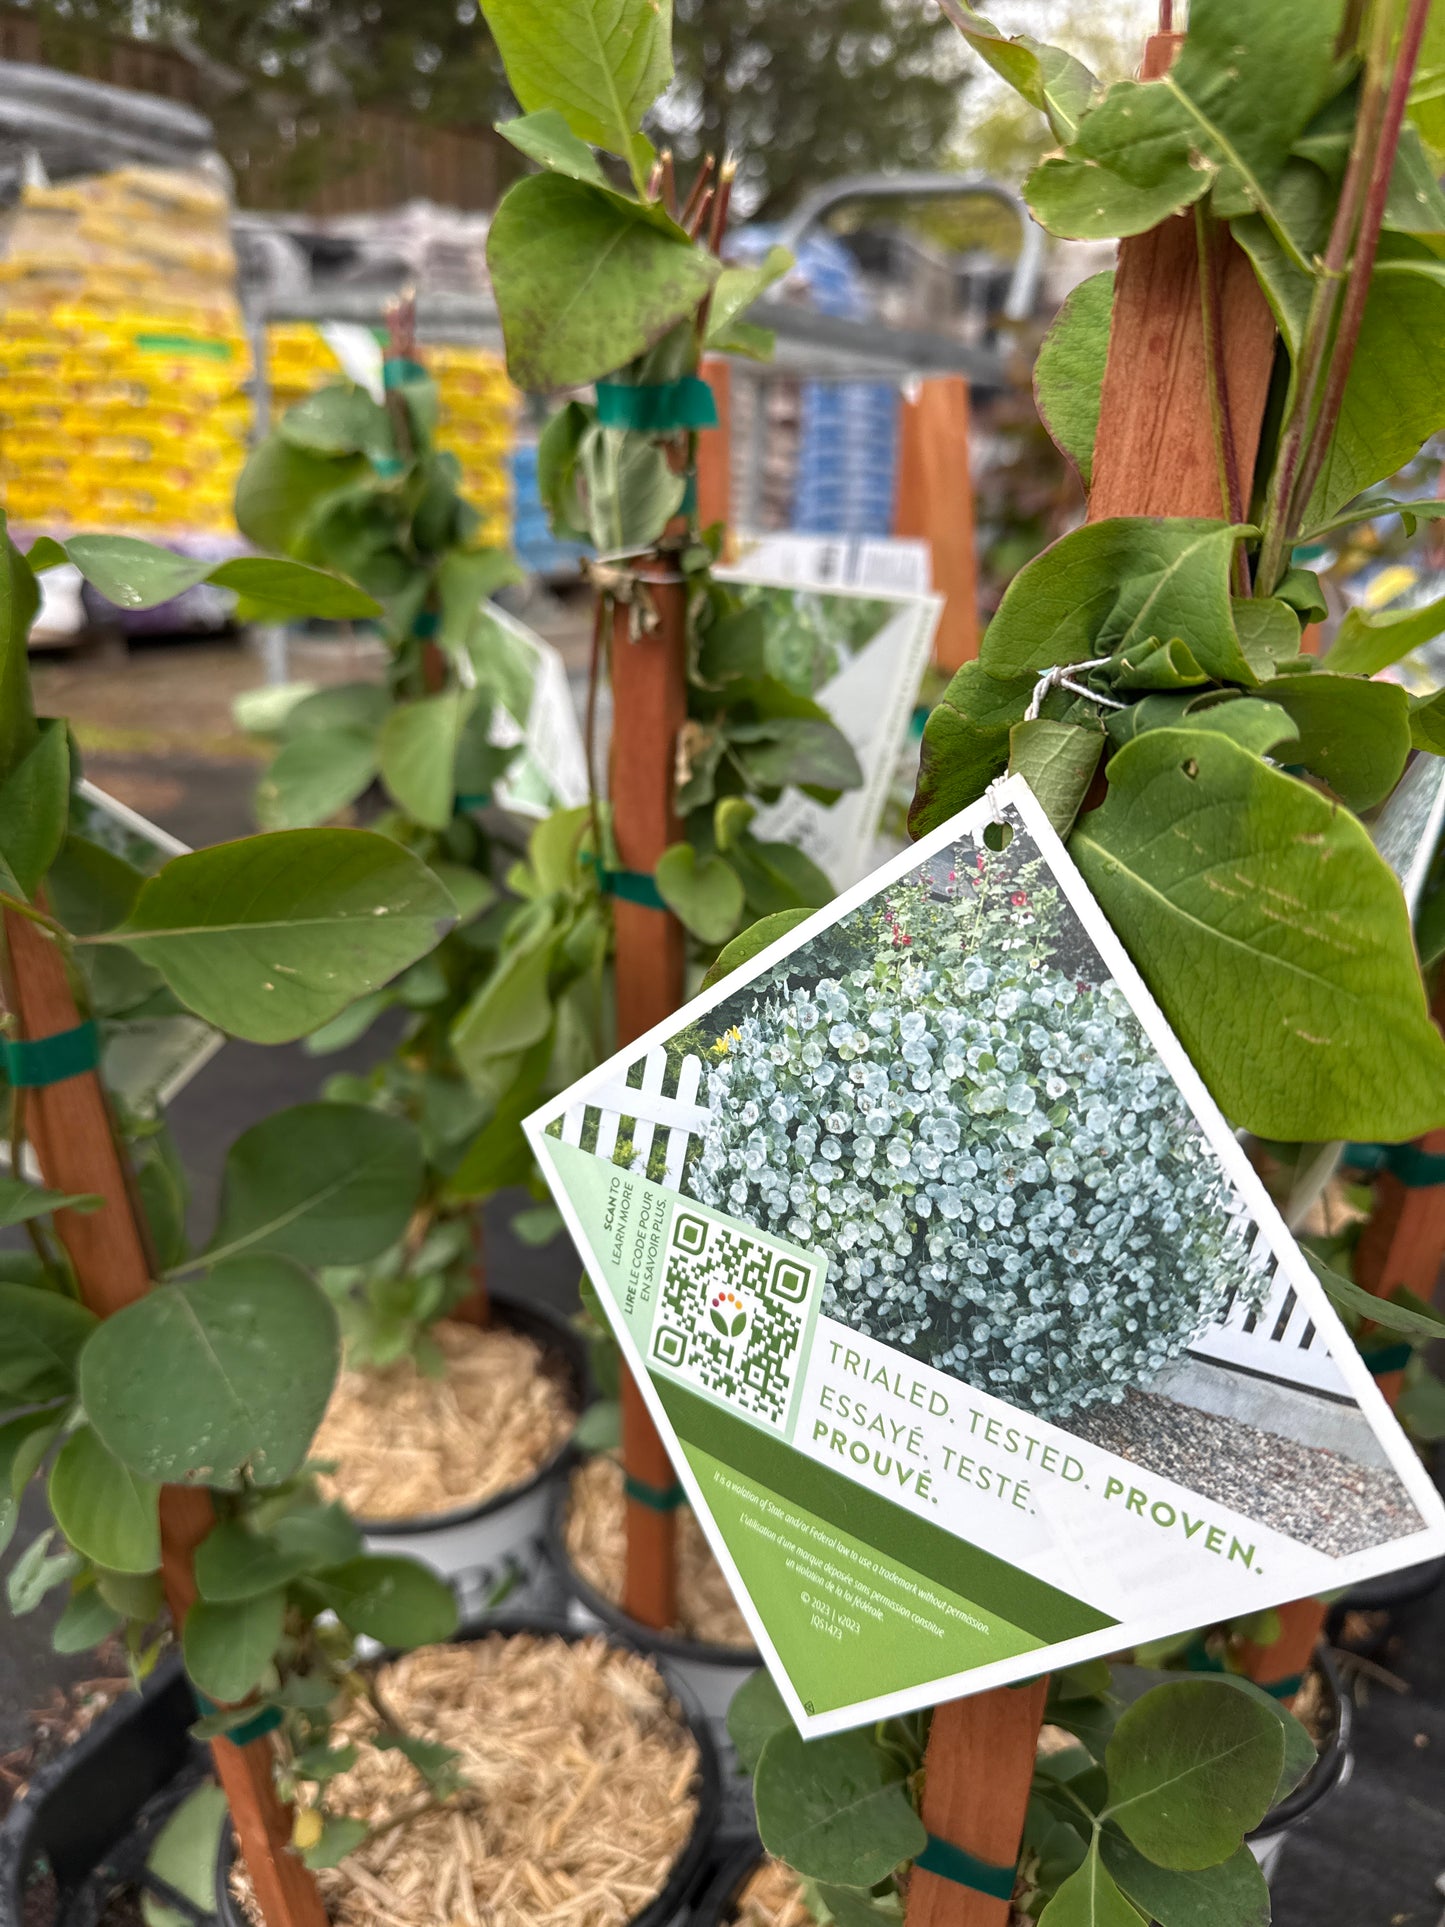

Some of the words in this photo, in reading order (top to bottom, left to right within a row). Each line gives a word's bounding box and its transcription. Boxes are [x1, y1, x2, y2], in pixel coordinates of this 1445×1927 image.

[610, 1177, 620, 1193] TO
[604, 1196, 617, 1231] SCAN
[612, 1222, 626, 1265] LEARN
[620, 1182, 634, 1223] MORE
[639, 1191, 653, 1229] POUR
[653, 1199, 667, 1232] PLUS.
[632, 1230, 647, 1268] CODE
[644, 1232, 660, 1281] SAVOIR
[629, 1269, 640, 1285] LE
[640, 1282, 652, 1301] EN
[625, 1286, 637, 1314] LIRE
[812, 1418, 938, 1504] PROUVÉ.
[819, 1384, 928, 1461] ESSAYÉ.
[942, 1445, 1036, 1516] TESTÉ.
[830, 1340, 955, 1424] TRIALED.
[969, 1408, 1089, 1490] TESTED.
[1104, 1475, 1263, 1575] PROVEN.
[720, 1476, 726, 1485] is
[726, 1480, 731, 1488] a
[732, 1483, 759, 1504] violation
[760, 1499, 767, 1512] of
[767, 1501, 785, 1519] State
[785, 1514, 810, 1534] and/or
[808, 1526, 837, 1548] Federal
[837, 1542, 850, 1556] law
[850, 1550, 859, 1560] to
[859, 1556, 872, 1569] use
[872, 1564, 879, 1573] a
[878, 1566, 917, 1594] trademark
[918, 1589, 947, 1612] without
[945, 1604, 990, 1636] permission.
[785, 1558, 795, 1569] un
[795, 1564, 824, 1587] violation
[824, 1582, 835, 1593] de
[835, 1585, 843, 1596] la
[843, 1590, 853, 1603] loi
[852, 1596, 885, 1623] fédérale.
[796, 1547, 823, 1569] marque
[824, 1562, 853, 1586] déposée
[854, 1580, 871, 1596] sans
[869, 1590, 911, 1619] permission
[911, 1613, 945, 1638] constitue
[811, 1597, 831, 1616] 2023
[837, 1614, 861, 1635] v2023
